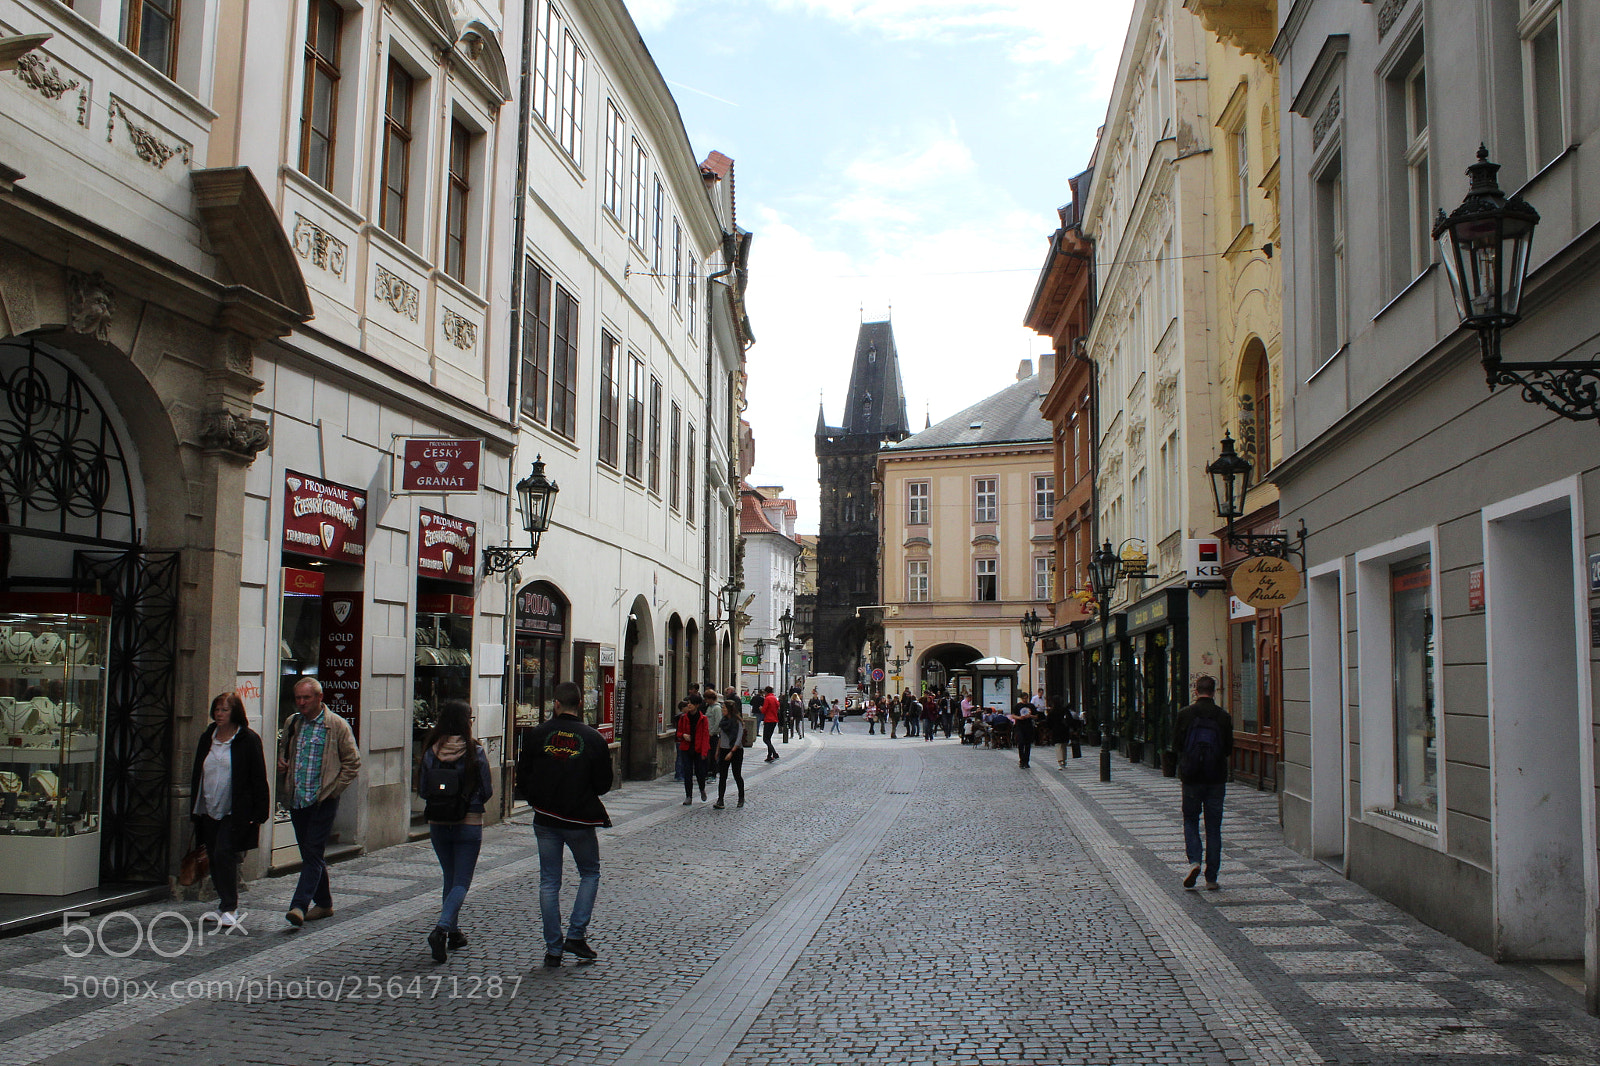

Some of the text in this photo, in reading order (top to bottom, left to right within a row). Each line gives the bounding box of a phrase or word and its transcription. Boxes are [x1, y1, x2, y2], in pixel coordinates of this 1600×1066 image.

[423, 447, 462, 458] ČESKÝ
[417, 475, 465, 487] GRANÁT
[1196, 566, 1222, 576] KB
[1247, 558, 1285, 574] Made
[1258, 575, 1277, 591] by
[1247, 587, 1287, 603] Praha
[524, 592, 550, 616] POLO
[328, 632, 354, 643] GOLD
[325, 657, 355, 668] SILVER
[321, 680, 360, 690] DIAMOND
